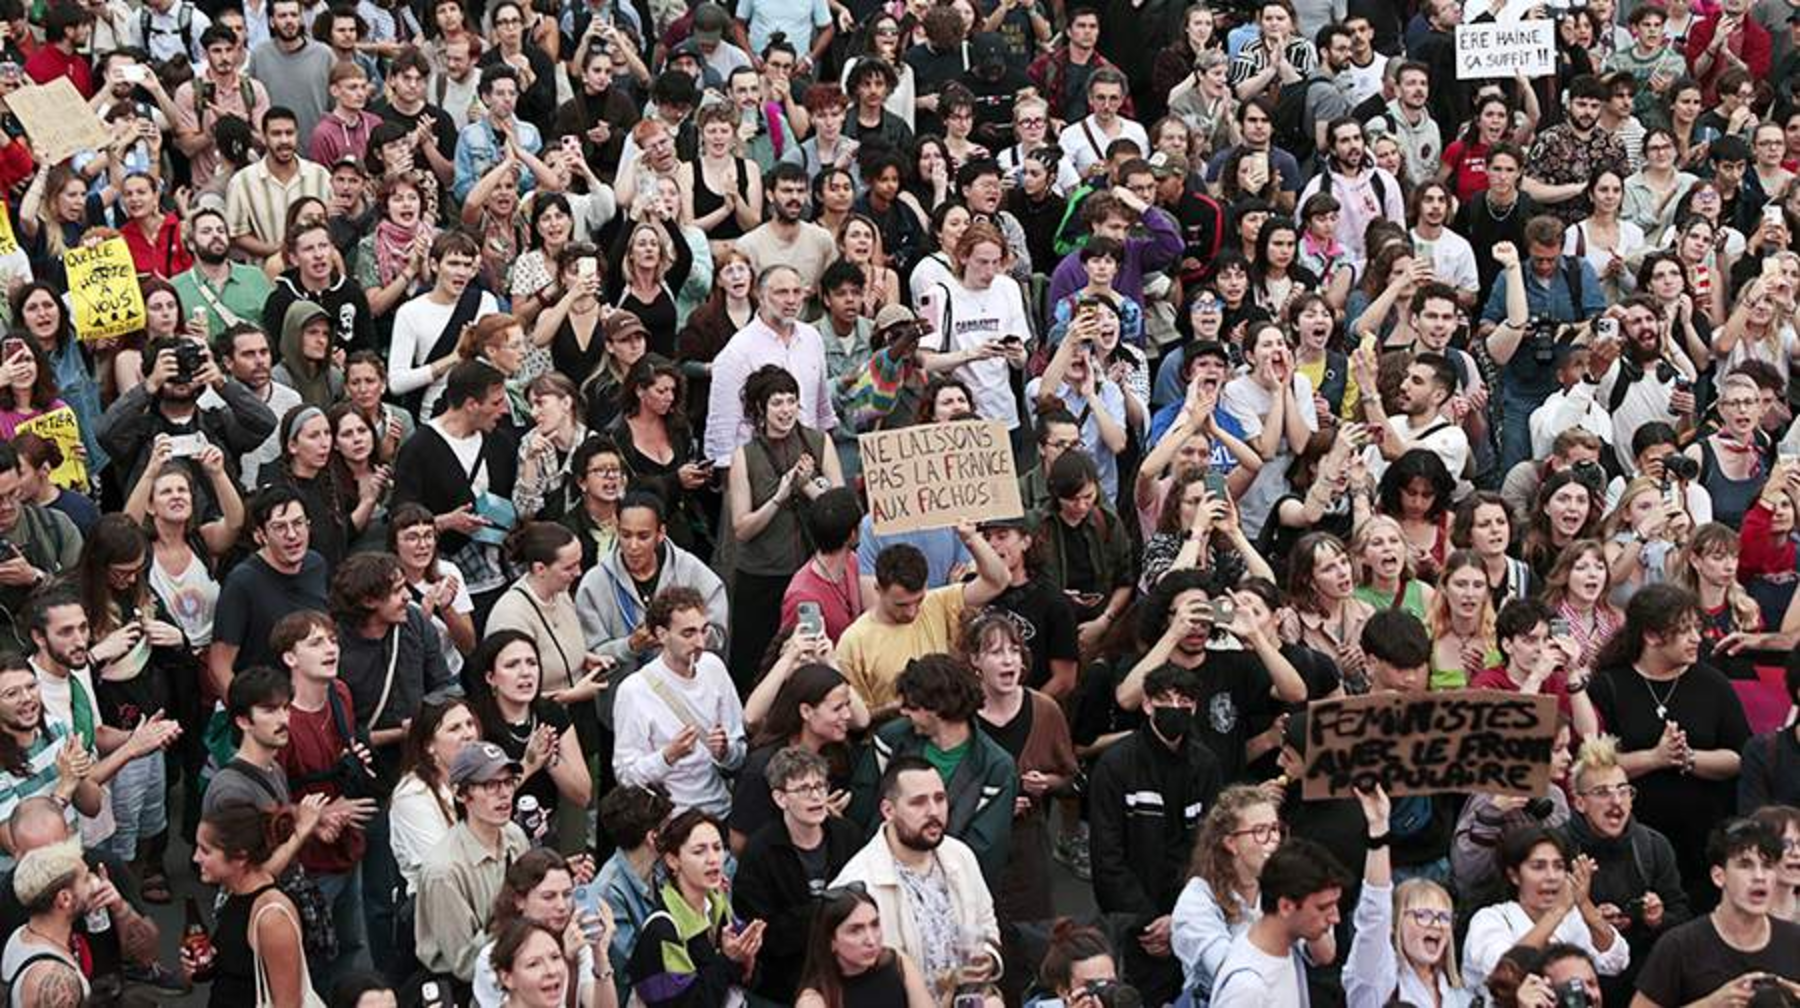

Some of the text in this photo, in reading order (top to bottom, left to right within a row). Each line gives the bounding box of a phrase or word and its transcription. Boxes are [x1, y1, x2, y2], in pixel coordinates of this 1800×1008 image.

[862, 424, 993, 465] NE LAISSONS
[867, 450, 1010, 491] PAS LA FRANCE
[872, 482, 991, 524] AUX FACHOS
[1306, 739, 1401, 780] AVEC
[1410, 738, 1450, 767] LE
